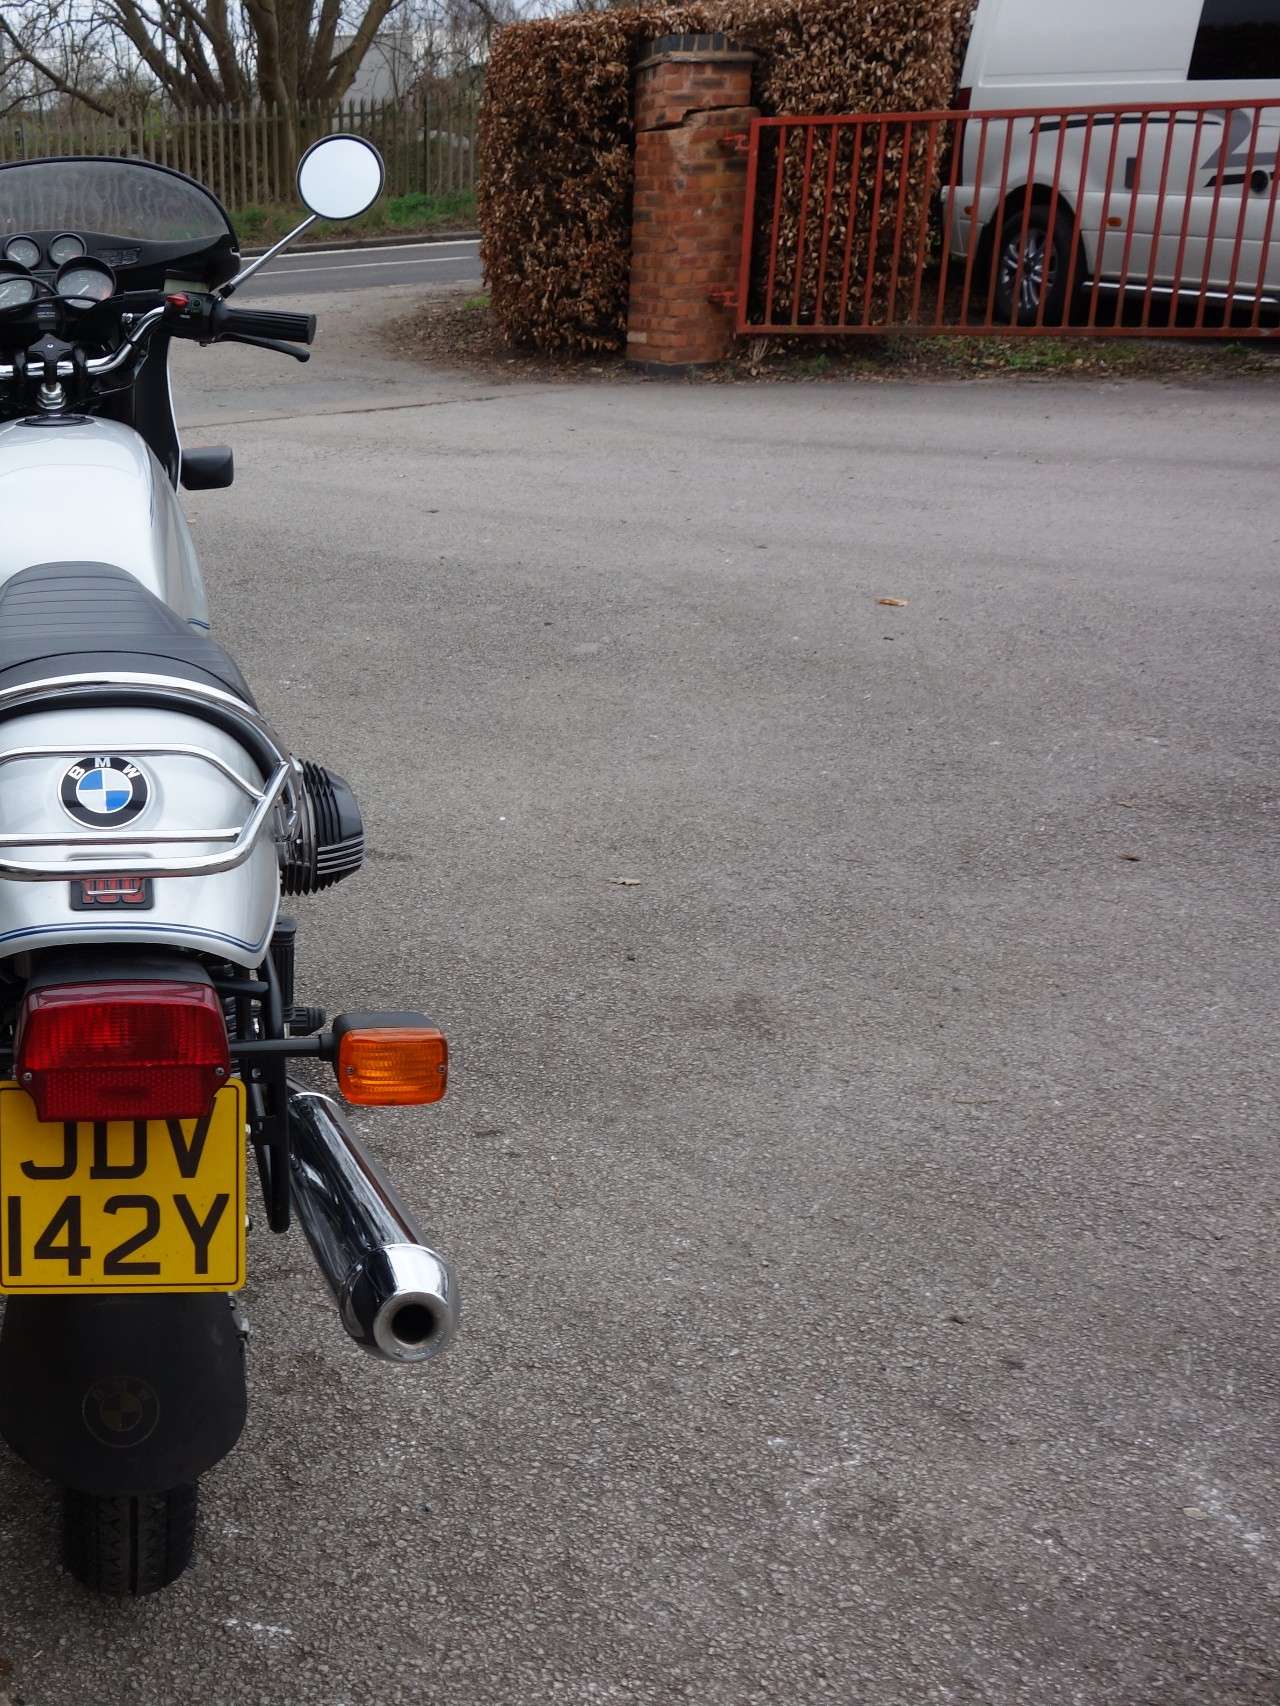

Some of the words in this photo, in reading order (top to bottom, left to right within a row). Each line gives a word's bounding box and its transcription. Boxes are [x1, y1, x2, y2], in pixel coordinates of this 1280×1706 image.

[67, 756, 141, 780] BMW
[20, 1099, 218, 1180] JDV
[7, 1194, 230, 1277] 142Y
